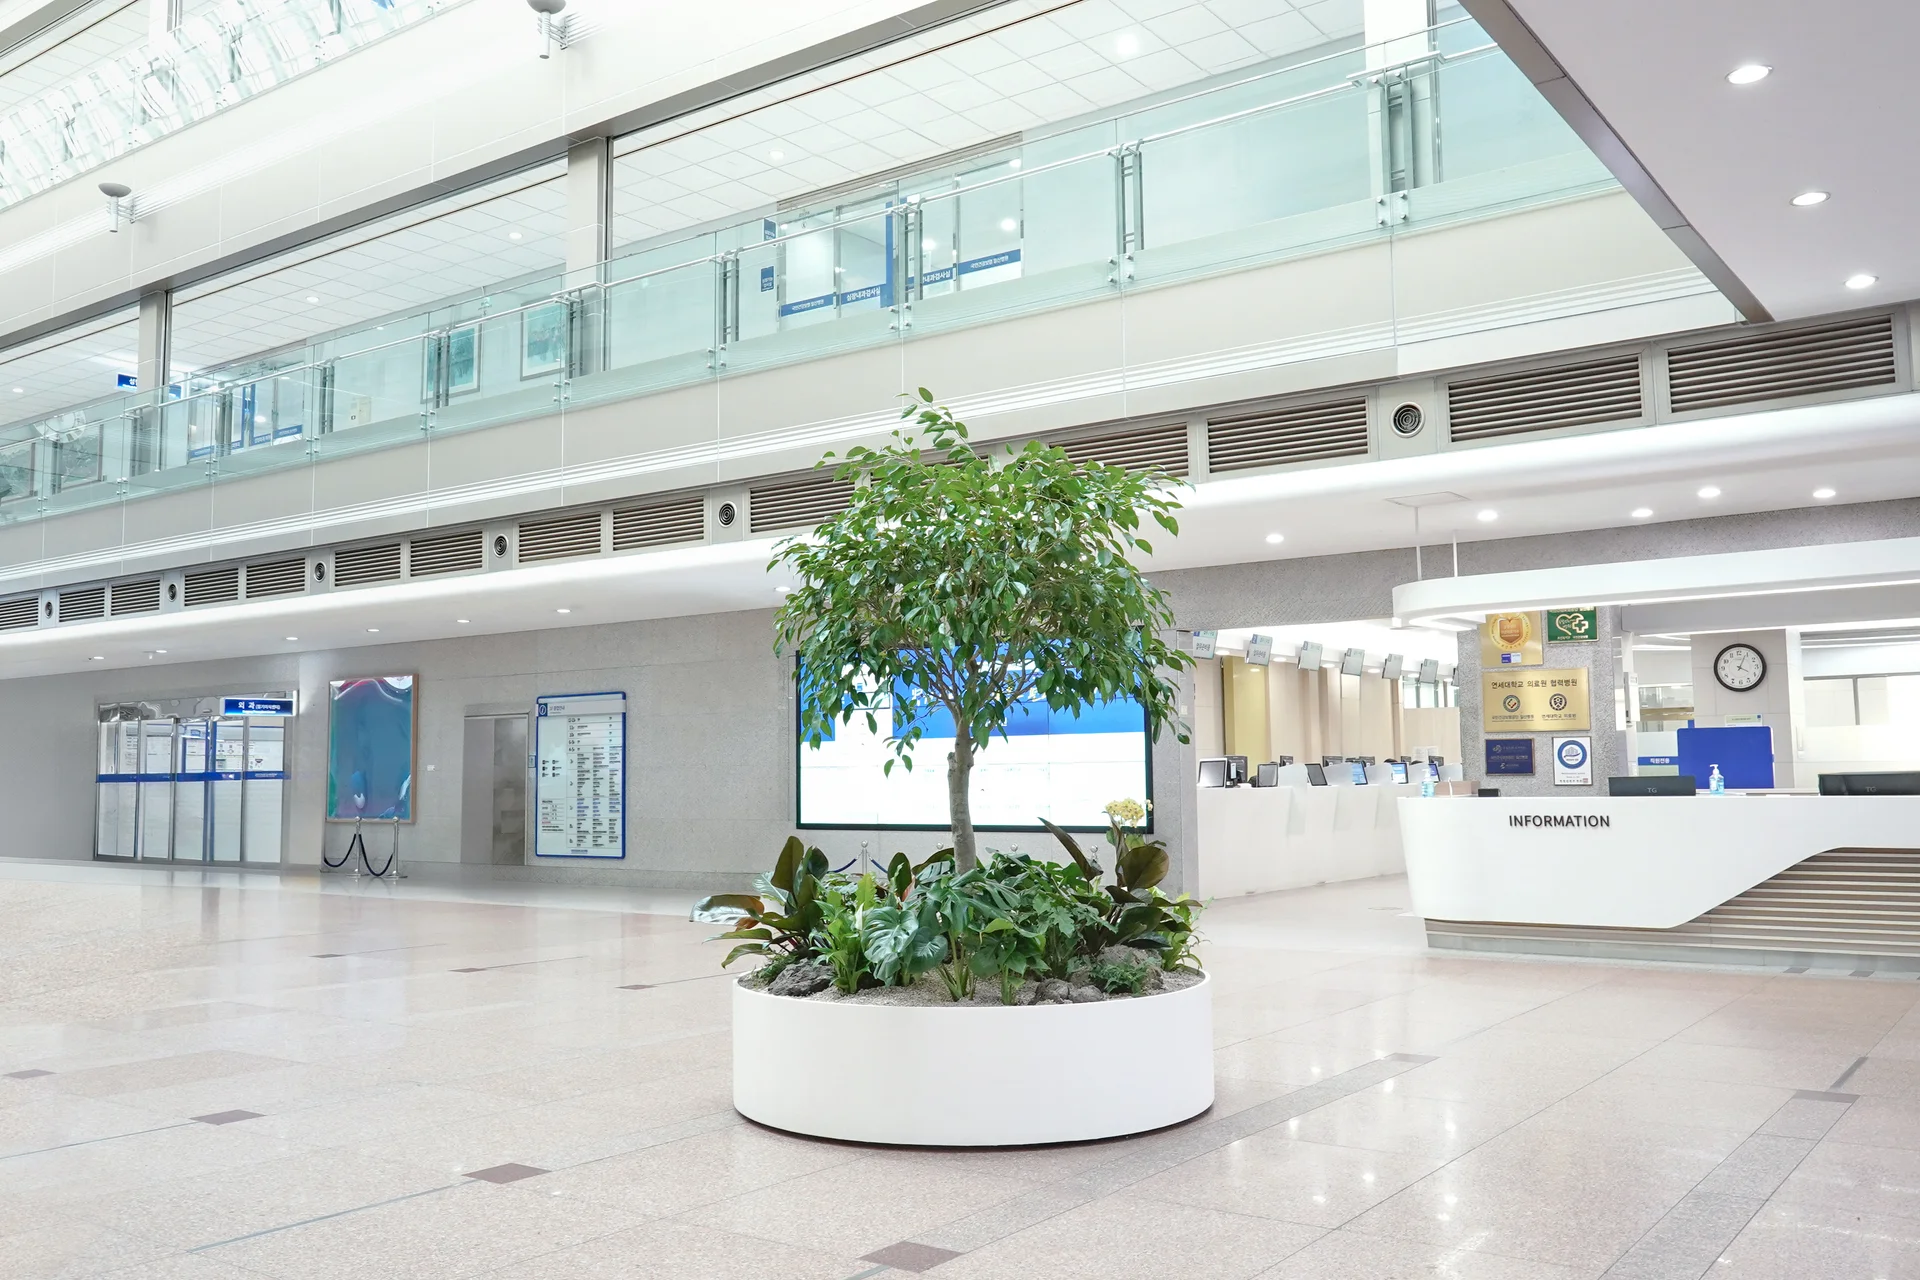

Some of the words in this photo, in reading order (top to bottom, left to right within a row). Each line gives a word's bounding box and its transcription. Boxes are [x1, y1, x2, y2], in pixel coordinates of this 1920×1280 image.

[922, 270, 950, 283] 내과검사실
[1491, 681, 1524, 689] 연세대학교
[1550, 678, 1577, 687] 협력병원
[1509, 815, 1610, 827] INFORMATION
